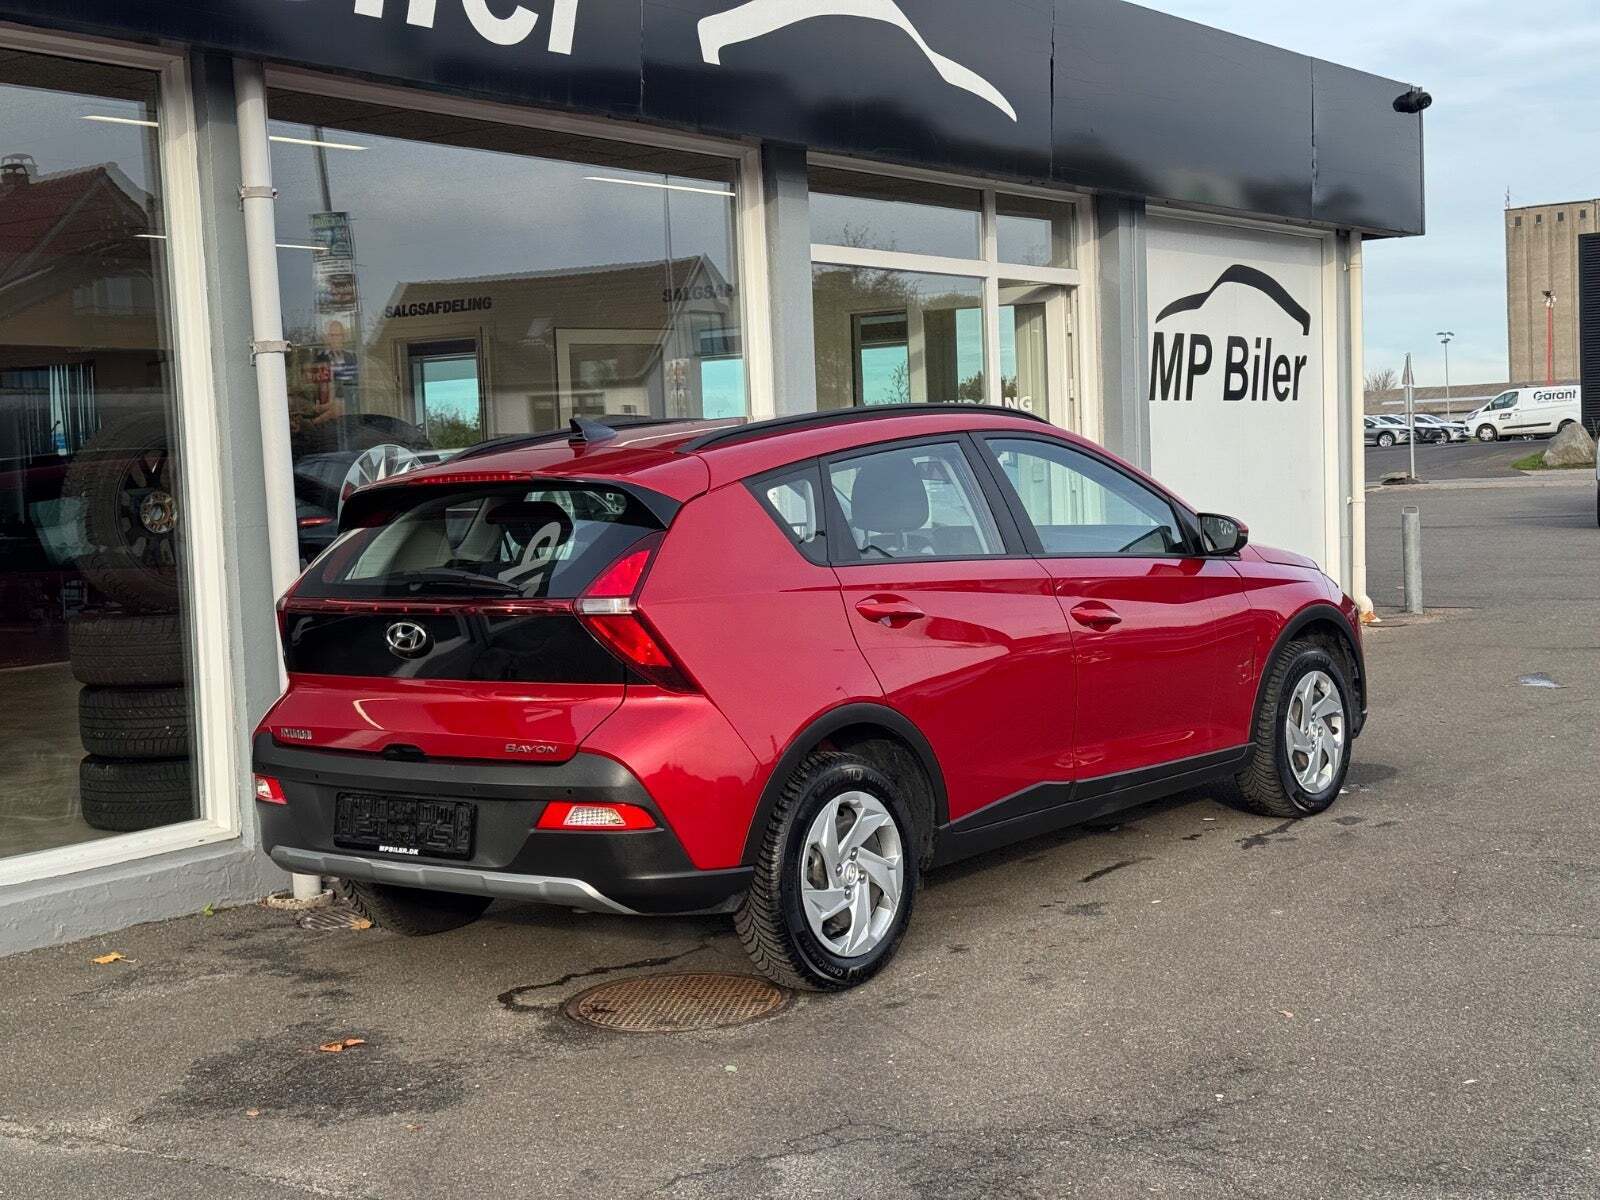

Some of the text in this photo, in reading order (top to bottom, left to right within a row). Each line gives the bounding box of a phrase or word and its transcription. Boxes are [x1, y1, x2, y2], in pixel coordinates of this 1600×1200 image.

[384, 297, 493, 319] SALGSAFDELING
[1149, 331, 1308, 402] MP Biler
[1533, 389, 1577, 401] Garant
